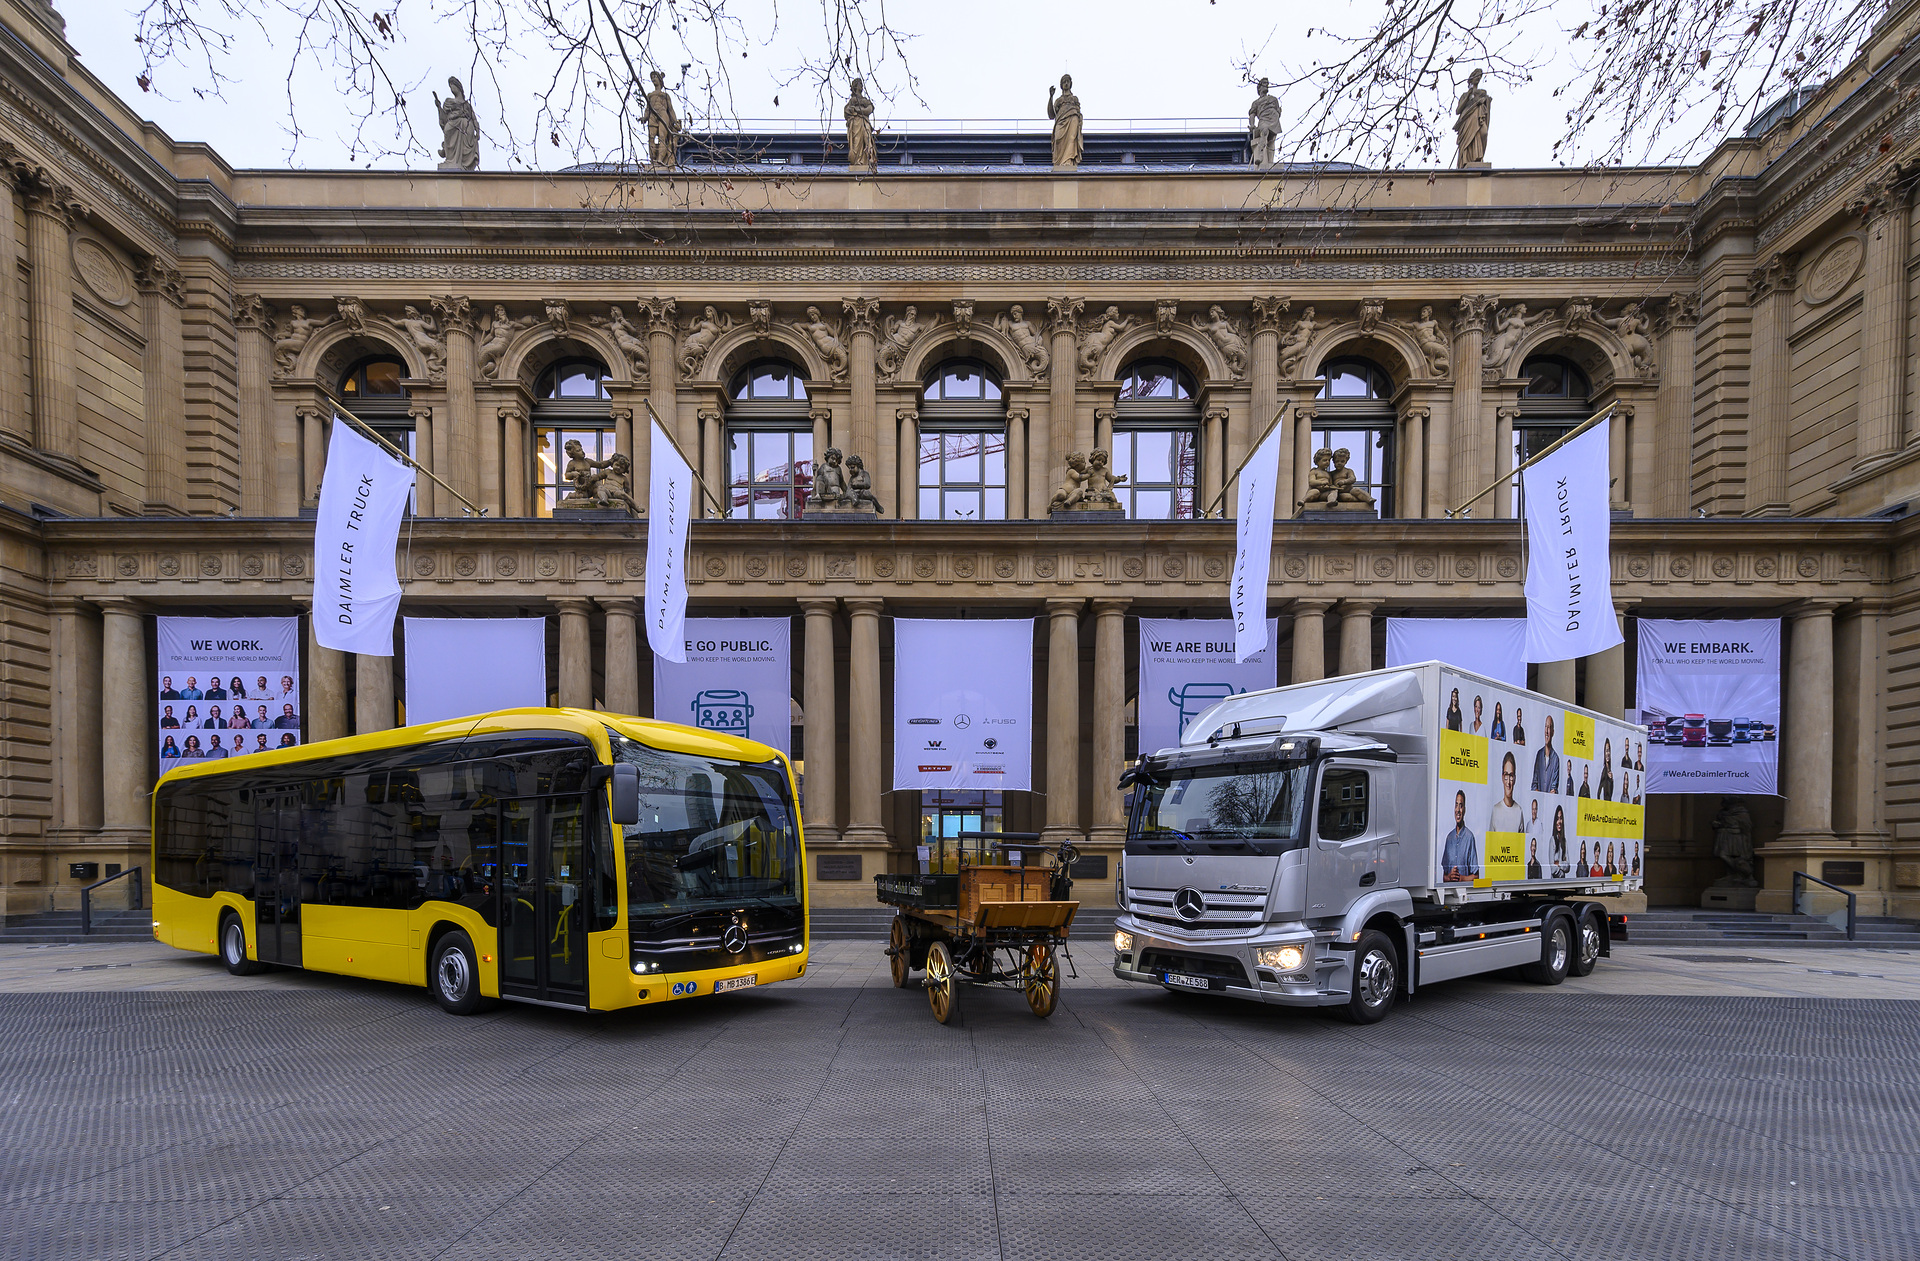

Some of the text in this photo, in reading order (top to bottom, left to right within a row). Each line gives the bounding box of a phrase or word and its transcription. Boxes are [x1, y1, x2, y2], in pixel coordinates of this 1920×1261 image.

[338, 474, 374, 625] DAIMLER TRUCK
[658, 547, 673, 629] DAIMLER
[190, 640, 264, 650] WE WORK.
[685, 640, 773, 652] E GO PUBLIC.
[1150, 642, 1172, 652] WE
[1176, 642, 1201, 652] ARE
[1664, 642, 1754, 654] WE EMBARK.
[1572, 738, 1586, 746] CARE.
[1460, 748, 1470, 757] WE
[1450, 756, 1479, 768] DELIVER.
[1662, 770, 1750, 778] #WeAreDaimlerTruck
[1584, 813, 1637, 826] #WeAreDaimlerTruck
[1168, 975, 1180, 984] GER
[719, 982, 724, 990] B
